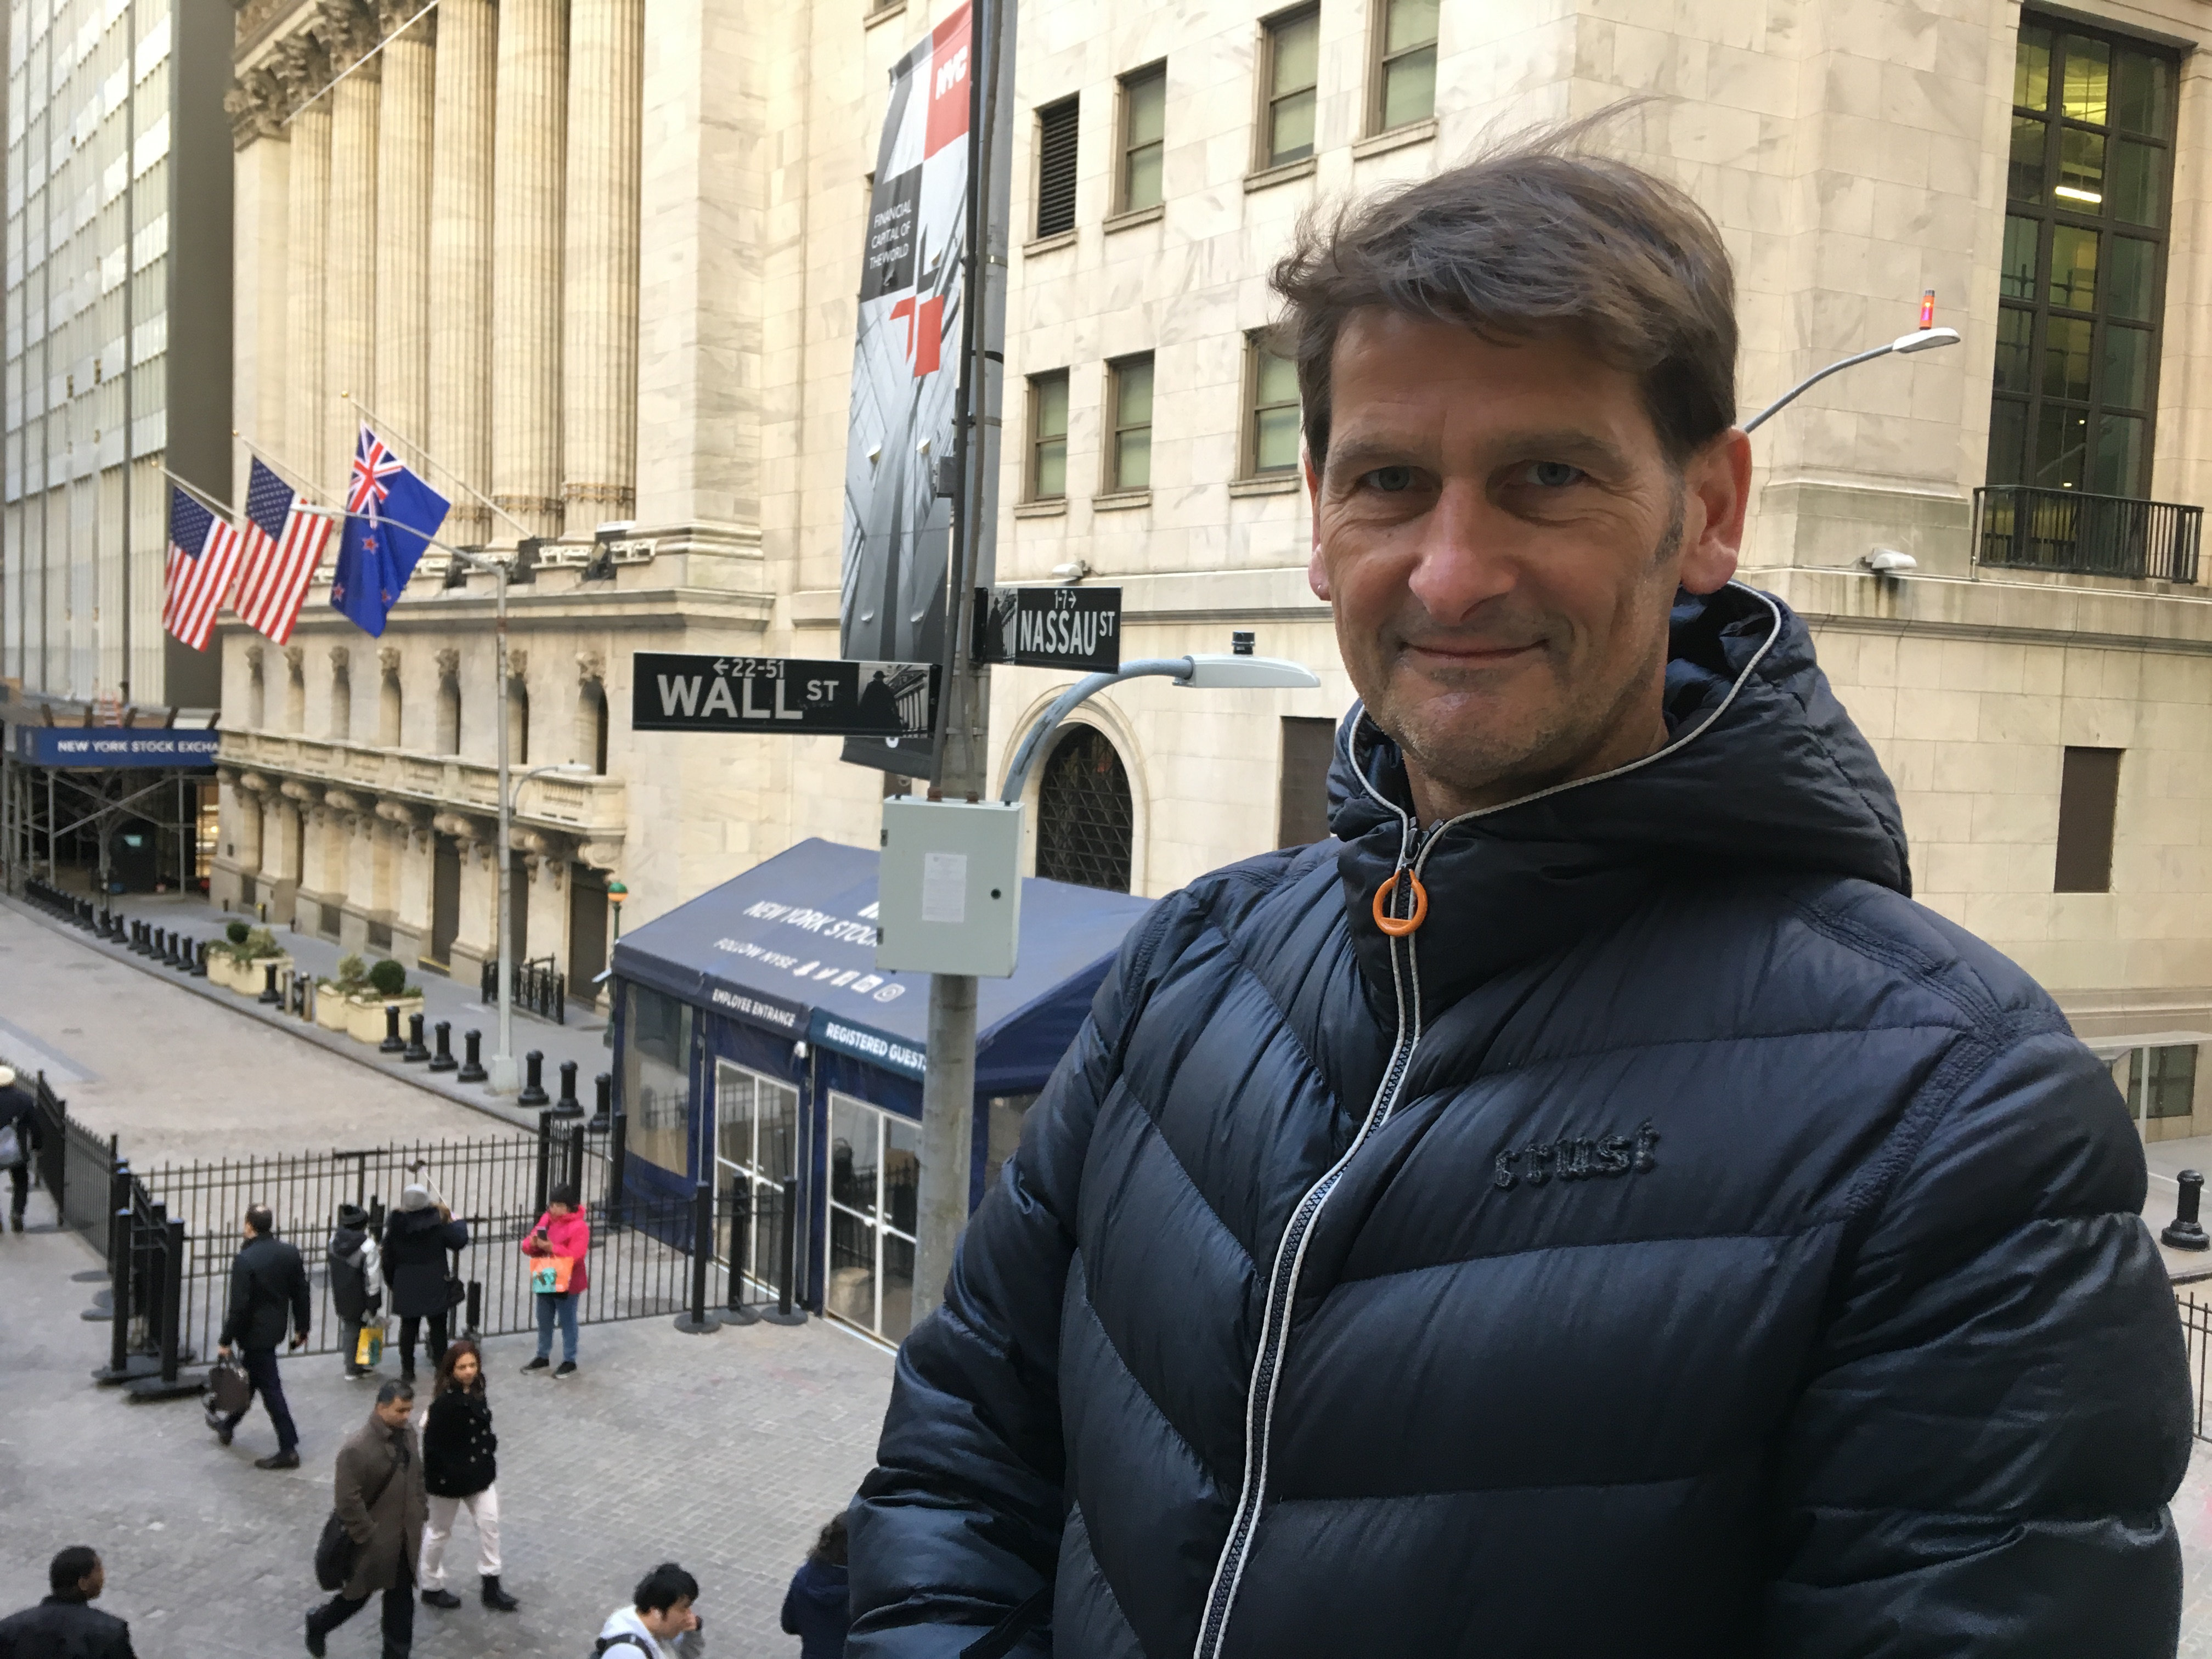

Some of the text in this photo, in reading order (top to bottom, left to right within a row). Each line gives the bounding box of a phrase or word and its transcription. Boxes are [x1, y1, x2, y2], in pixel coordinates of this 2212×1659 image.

[935, 45, 968, 100] NYC
[873, 199, 912, 228] FINANCIAL
[871, 221, 911, 249] CAPITAL OF
[870, 242, 909, 269] THE WORLD
[1054, 590, 1067, 609] 1-7
[1020, 610, 1115, 656] NASSAU ST
[732, 658, 784, 678] 22-51
[657, 674, 839, 719] WALL ST
[57, 740, 89, 753] NEW
[92, 740, 127, 753] YORK
[131, 740, 174, 753] STOCK
[743, 900, 792, 921] NEW
[780, 907, 836, 932] YORK
[714, 938, 798, 969] FOLLOW NYSE
[712, 988, 795, 1027] EMPLOYEE ENTRANCE
[826, 1022, 888, 1057] REGISTERED
